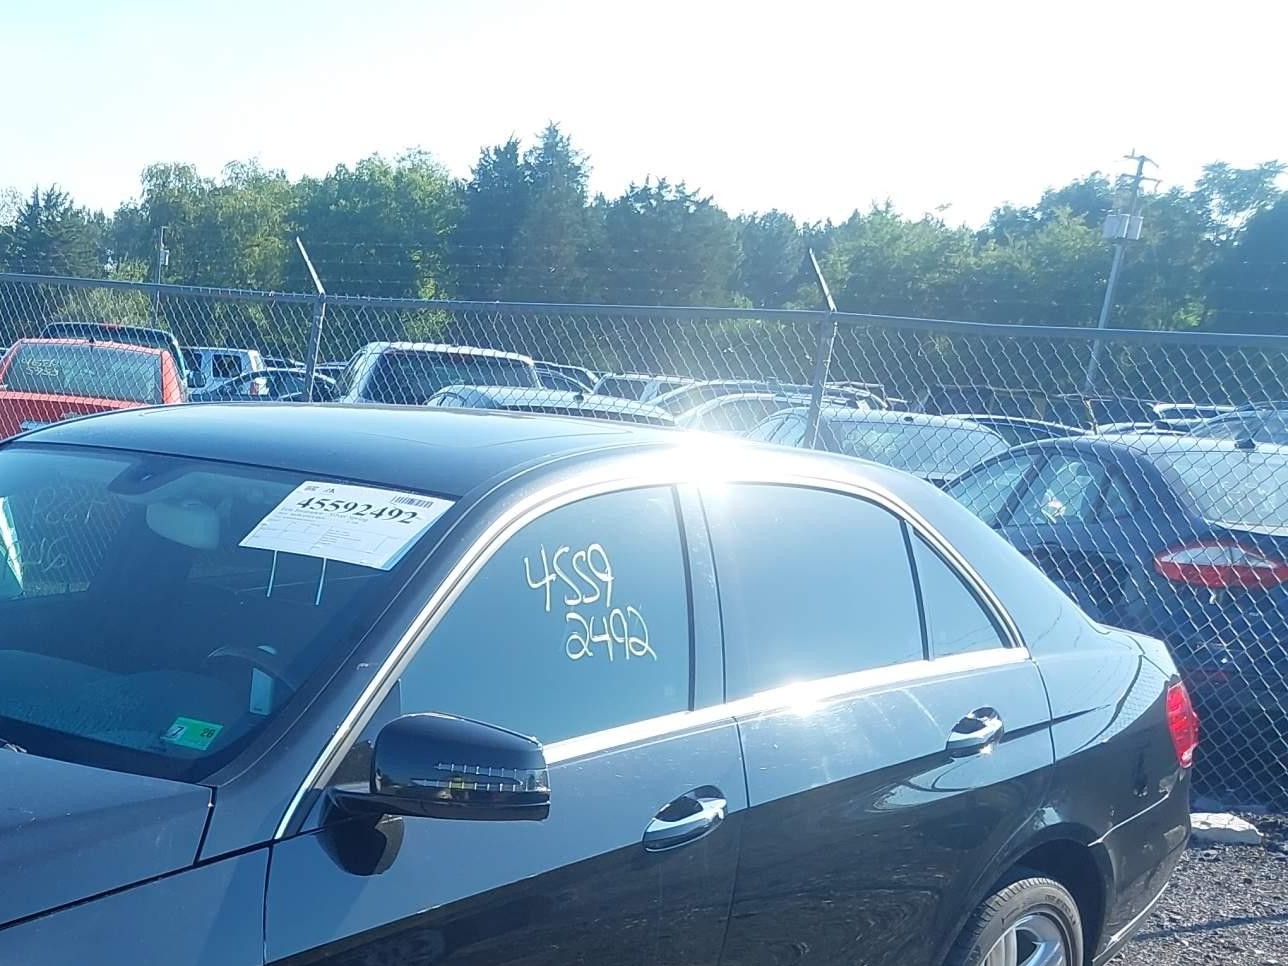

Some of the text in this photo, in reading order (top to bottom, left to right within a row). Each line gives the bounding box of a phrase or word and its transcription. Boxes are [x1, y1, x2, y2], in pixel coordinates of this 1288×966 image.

[297, 497, 418, 524] 45592492
[524, 544, 614, 612] 4559
[566, 606, 657, 661] 2492
